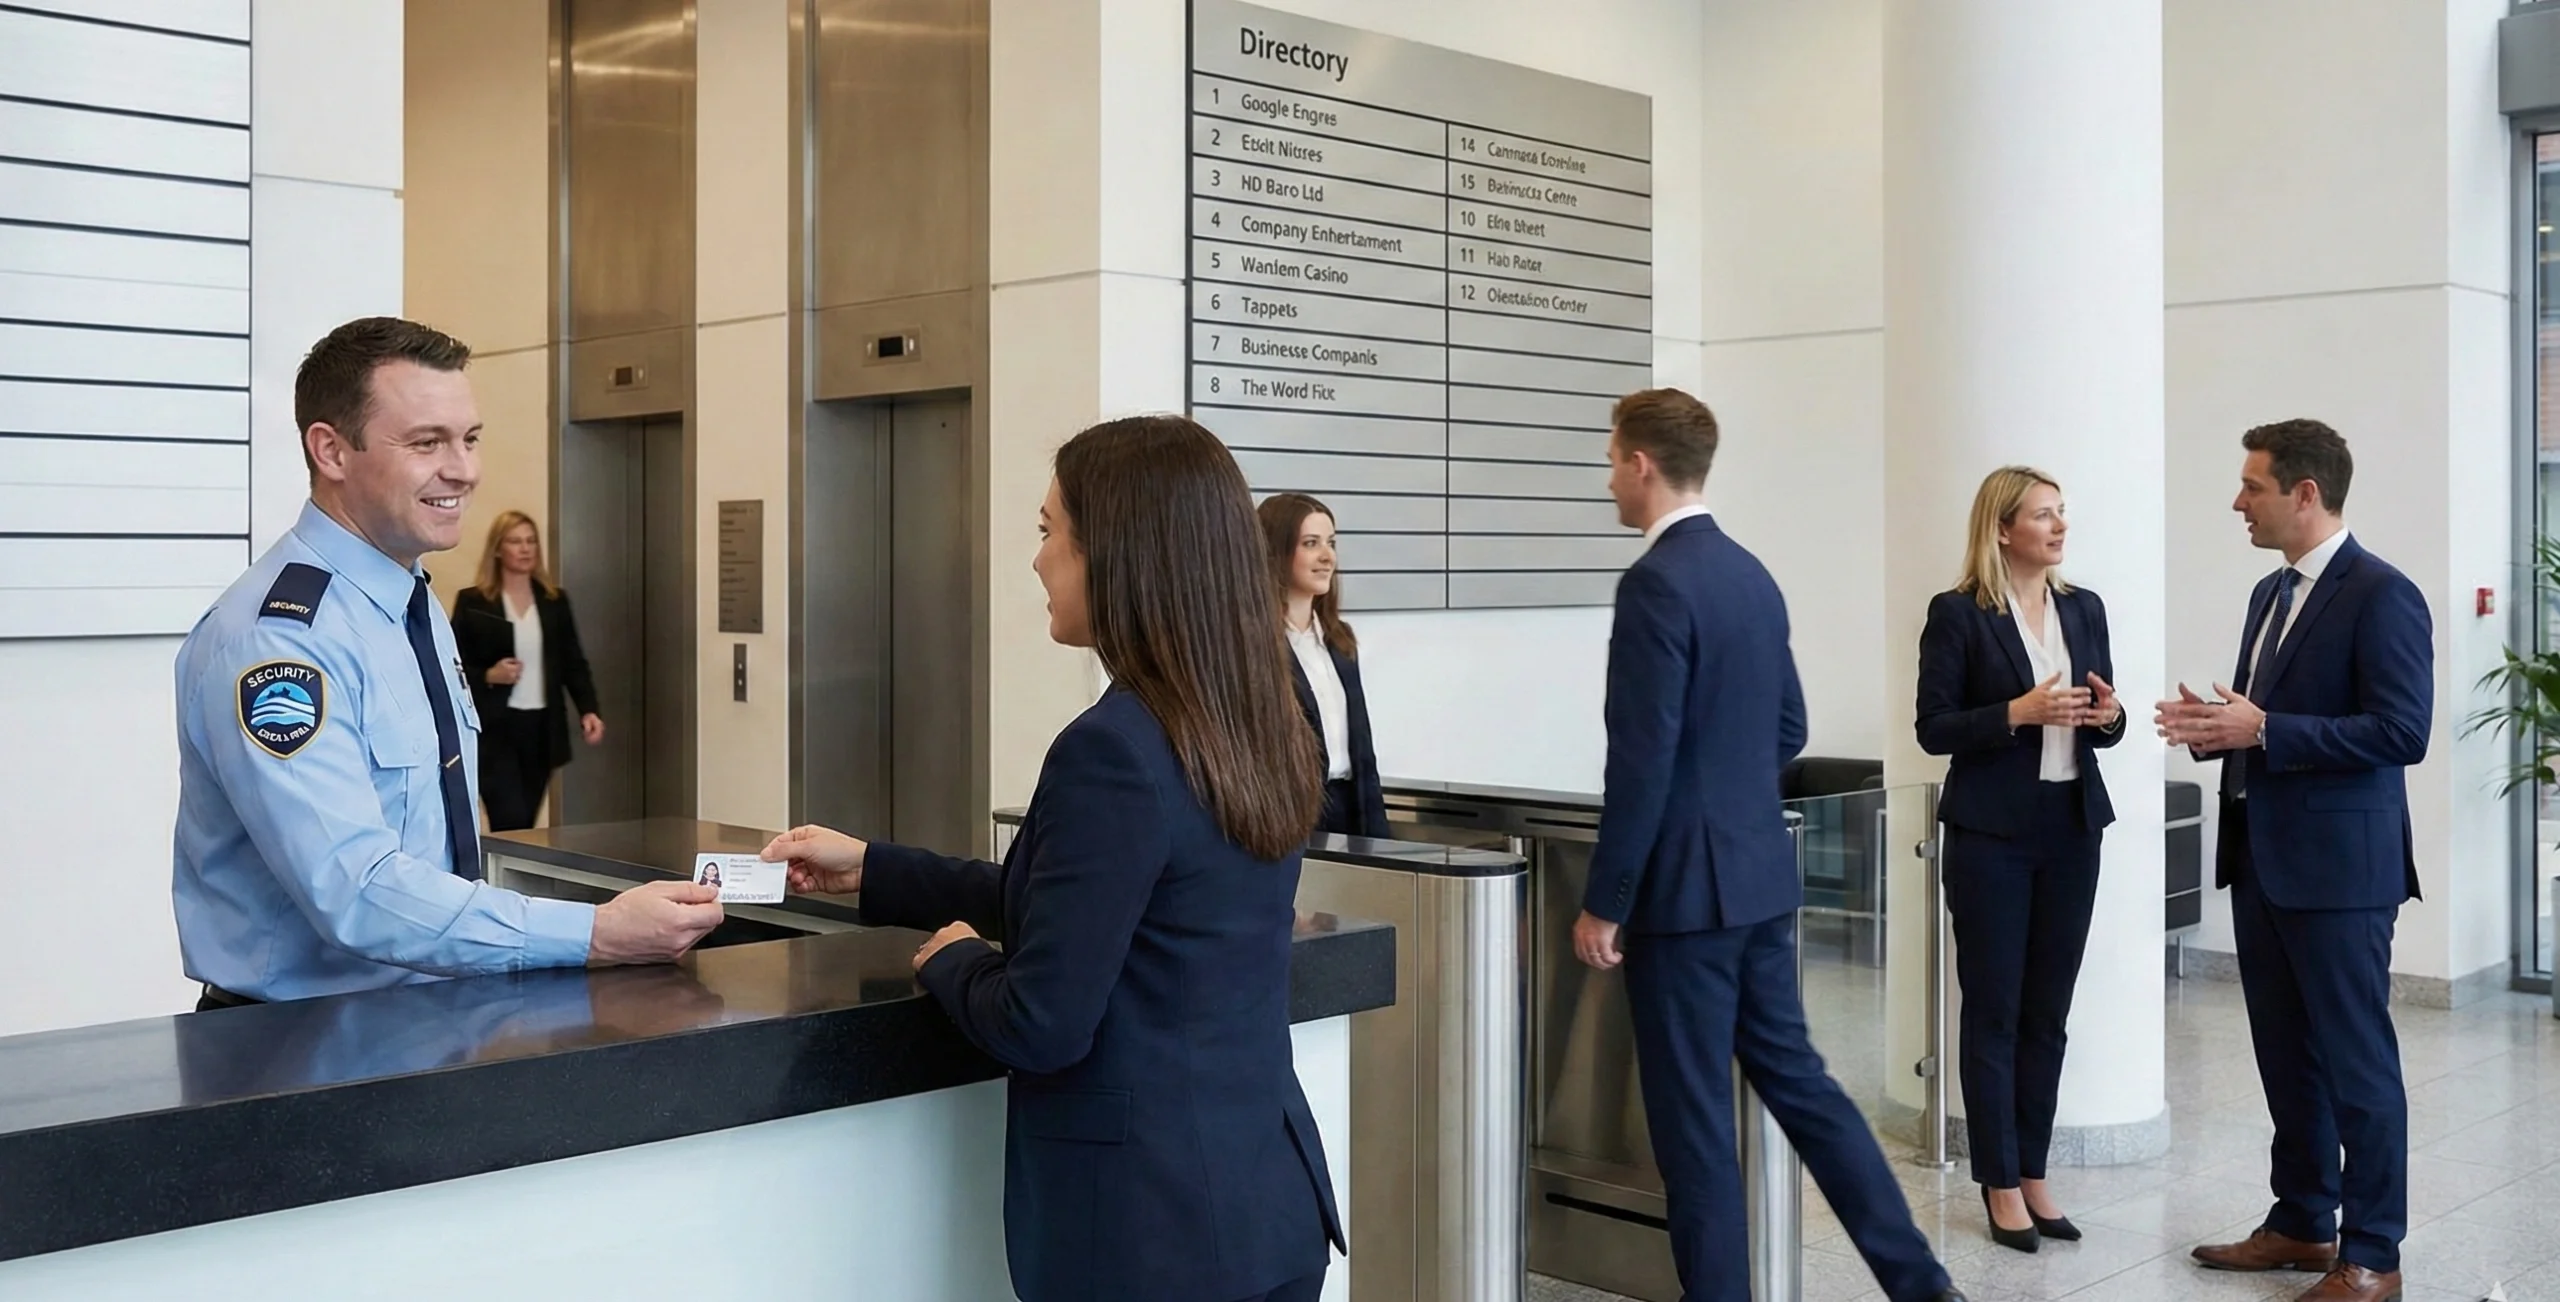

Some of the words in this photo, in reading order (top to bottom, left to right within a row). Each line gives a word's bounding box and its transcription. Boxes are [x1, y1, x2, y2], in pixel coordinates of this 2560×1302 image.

[1240, 26, 1349, 82] Directory
[1212, 87, 1219, 104] 1
[1241, 93, 1289, 119] Google
[1211, 128, 1220, 146] 2
[1461, 136, 1475, 153] 14
[1211, 169, 1221, 187] 3
[1461, 172, 1475, 191] 15
[1266, 178, 1299, 199] Baro
[1211, 211, 1221, 228] 4
[1461, 210, 1476, 227] 10
[1241, 215, 1308, 243] Company
[1211, 252, 1221, 269] 5
[1461, 247, 1475, 263] 11
[1304, 263, 1349, 285] Casino
[1461, 284, 1476, 300] 12
[1211, 293, 1221, 311] 6
[1211, 335, 1221, 351] 7
[1210, 376, 1221, 394] 8
[1241, 378, 1268, 397] The
[1270, 380, 1308, 400] Word
[247, 666, 316, 689] SECURITY
